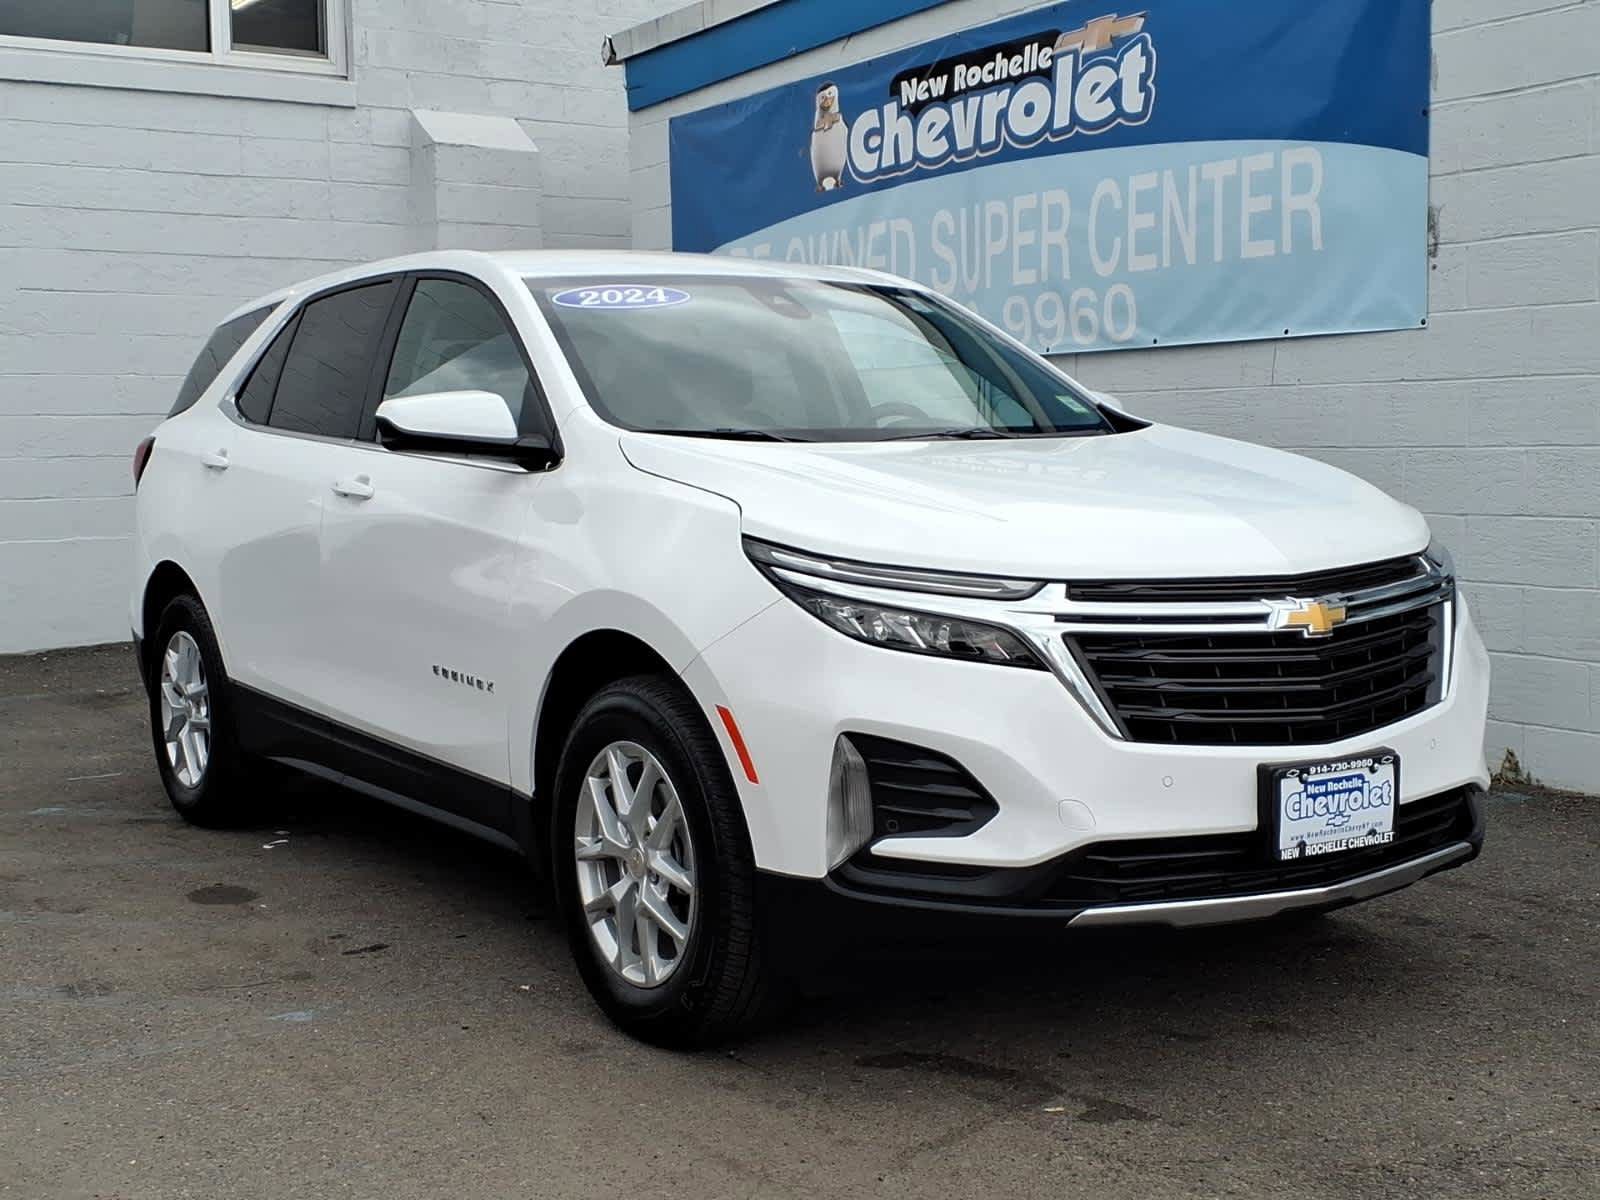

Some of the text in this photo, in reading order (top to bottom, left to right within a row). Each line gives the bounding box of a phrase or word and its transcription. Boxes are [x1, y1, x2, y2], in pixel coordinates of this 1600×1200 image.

[901, 43, 1053, 106] New Rochelle
[849, 42, 1148, 174] Chevrolet
[929, 188, 1071, 294] SUPER
[1088, 146, 1324, 278] CENTER
[578, 287, 669, 305] 2024
[1002, 283, 1137, 348] 9960
[1286, 780, 1391, 821] Chevrolet
[1307, 777, 1363, 795] New Rochelle
[1281, 831, 1395, 860] NEW ROCHELLE CHEVROLET
